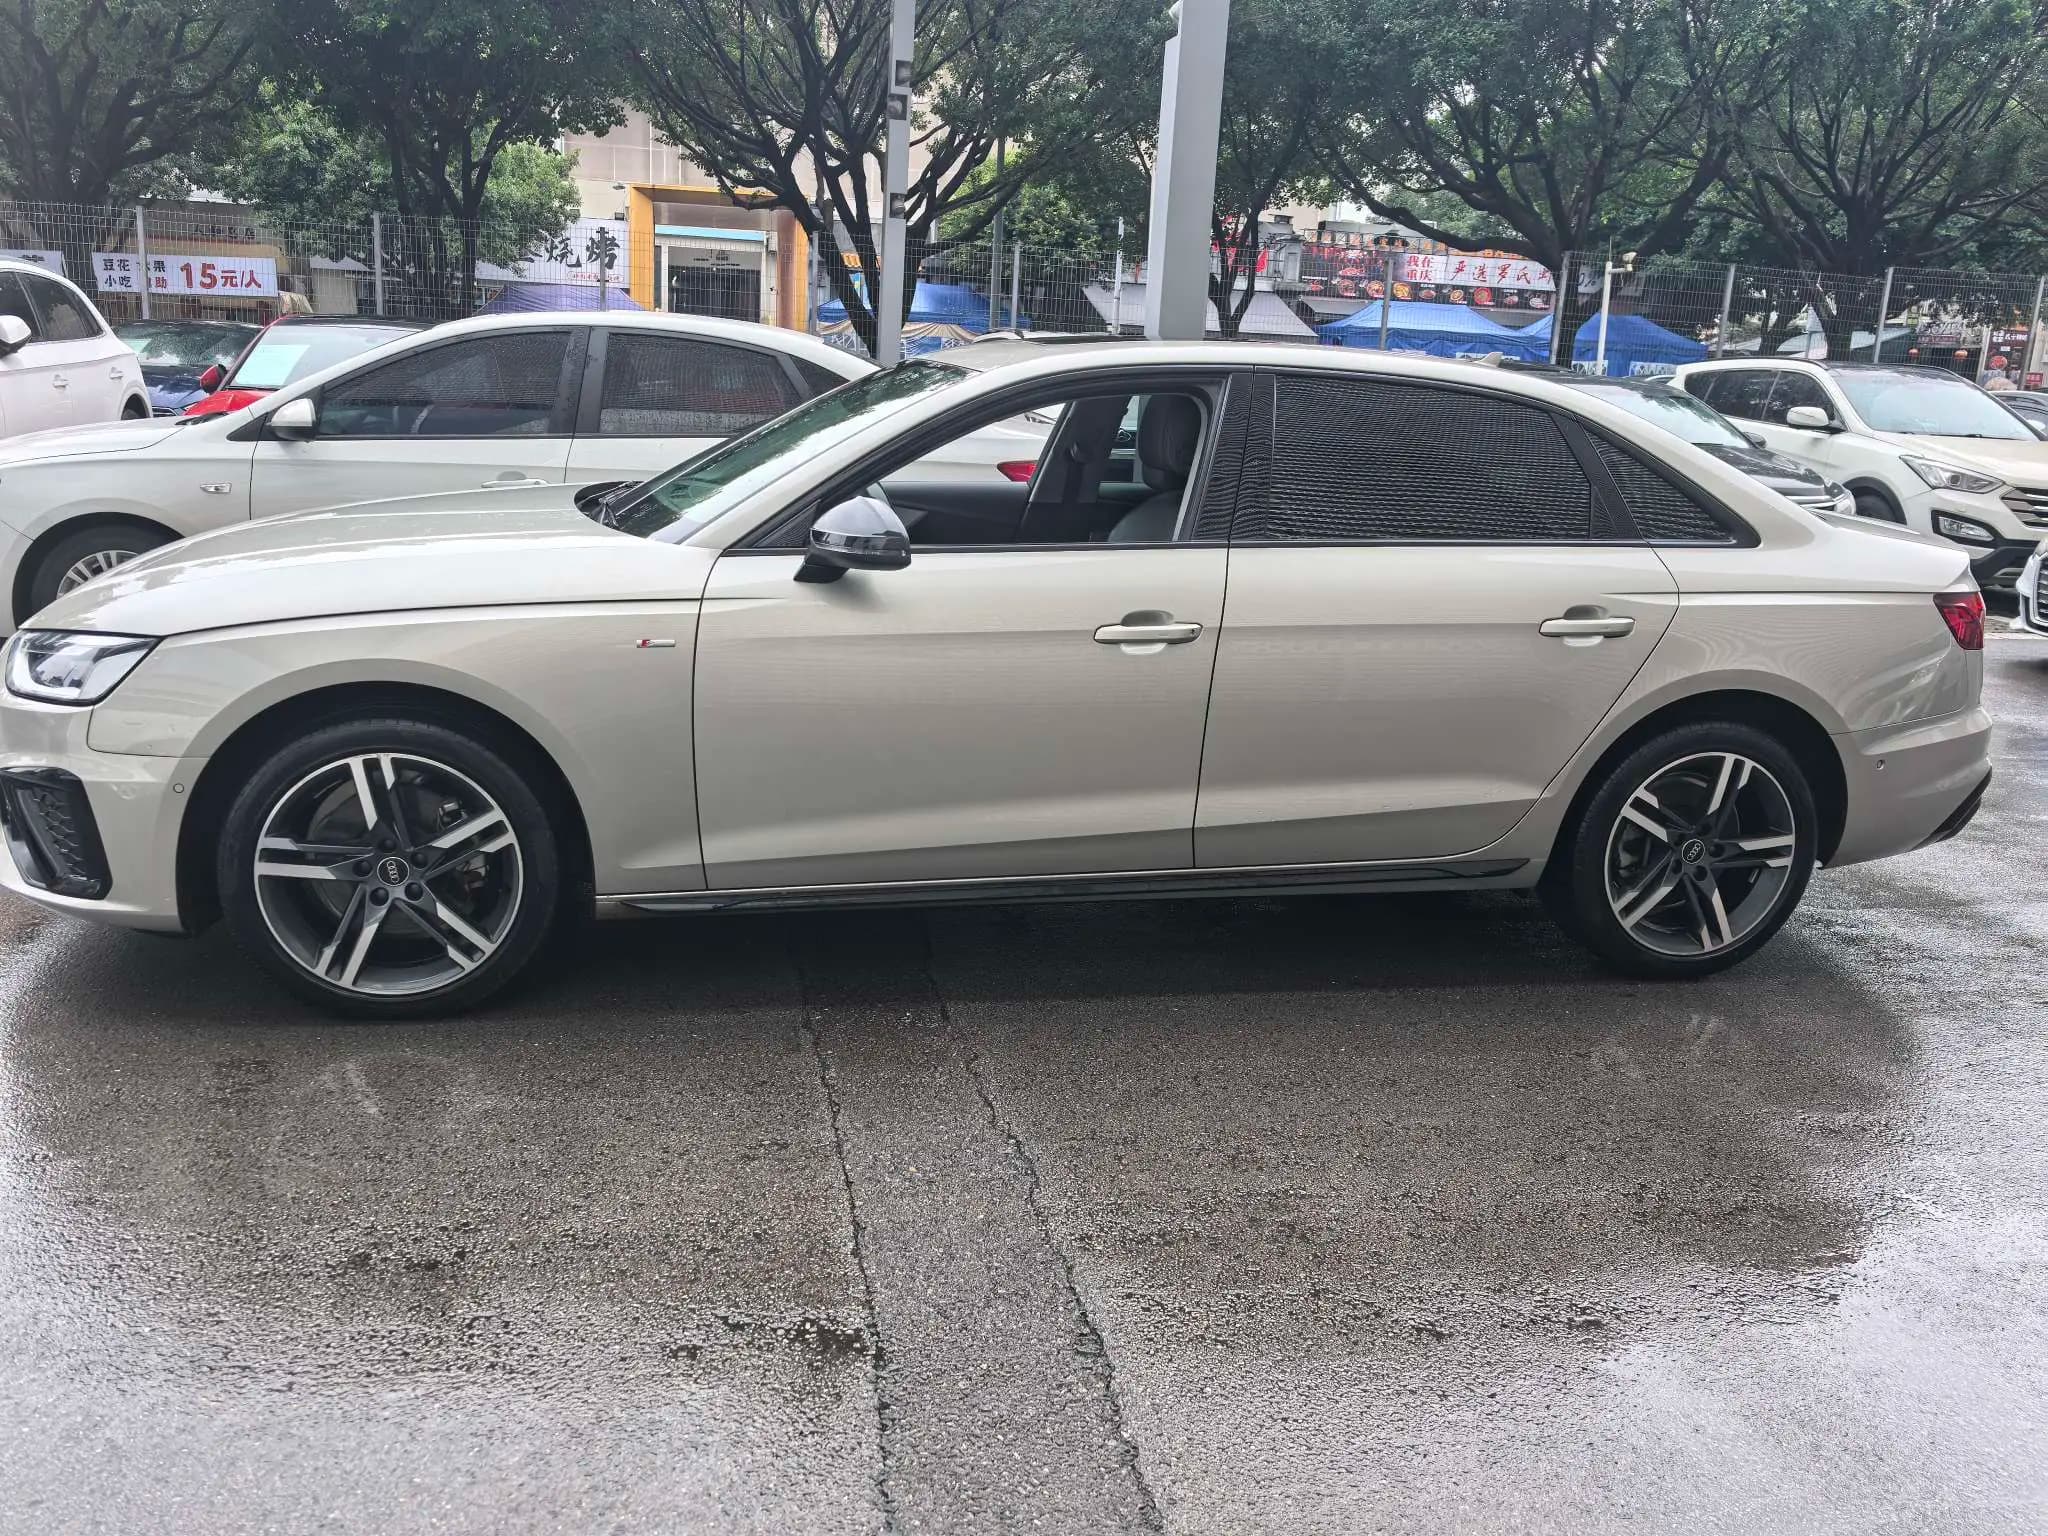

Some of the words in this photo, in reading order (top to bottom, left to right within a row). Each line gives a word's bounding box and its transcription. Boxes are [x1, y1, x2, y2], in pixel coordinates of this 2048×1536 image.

[102, 258, 131, 272] 豆花
[1407, 254, 1433, 267] 我在
[104, 274, 132, 288] 小吃
[180, 262, 262, 290] 15元/人
[1407, 269, 1433, 281] 重庆
